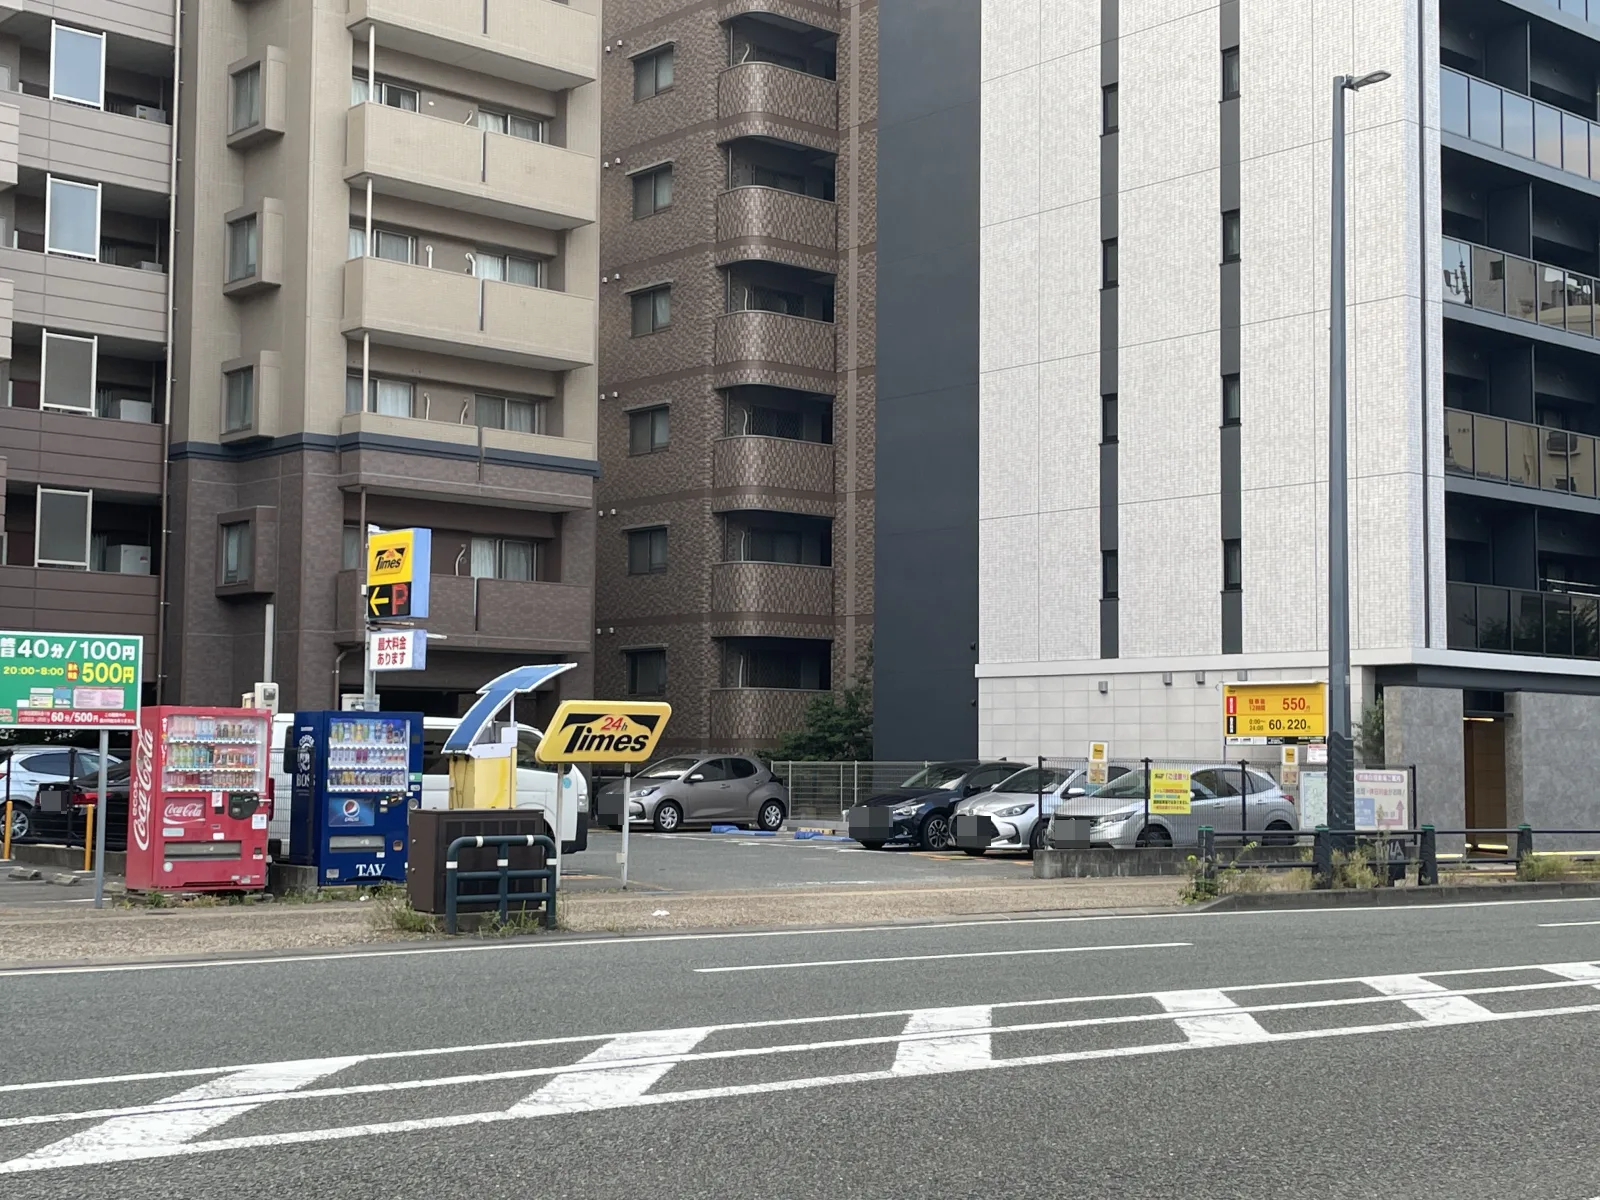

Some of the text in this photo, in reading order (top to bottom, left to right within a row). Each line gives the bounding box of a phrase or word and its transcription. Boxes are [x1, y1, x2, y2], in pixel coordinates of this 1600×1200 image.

[375, 556, 402, 572] Times
[391, 583, 409, 615] P
[378, 636, 407, 651] 最大料金
[377, 652, 406, 666] あります
[3, 666, 64, 676] 20:00-8:00
[82, 662, 135, 684] 500円
[600, 716, 628, 732] 24h
[563, 725, 650, 754] Times
